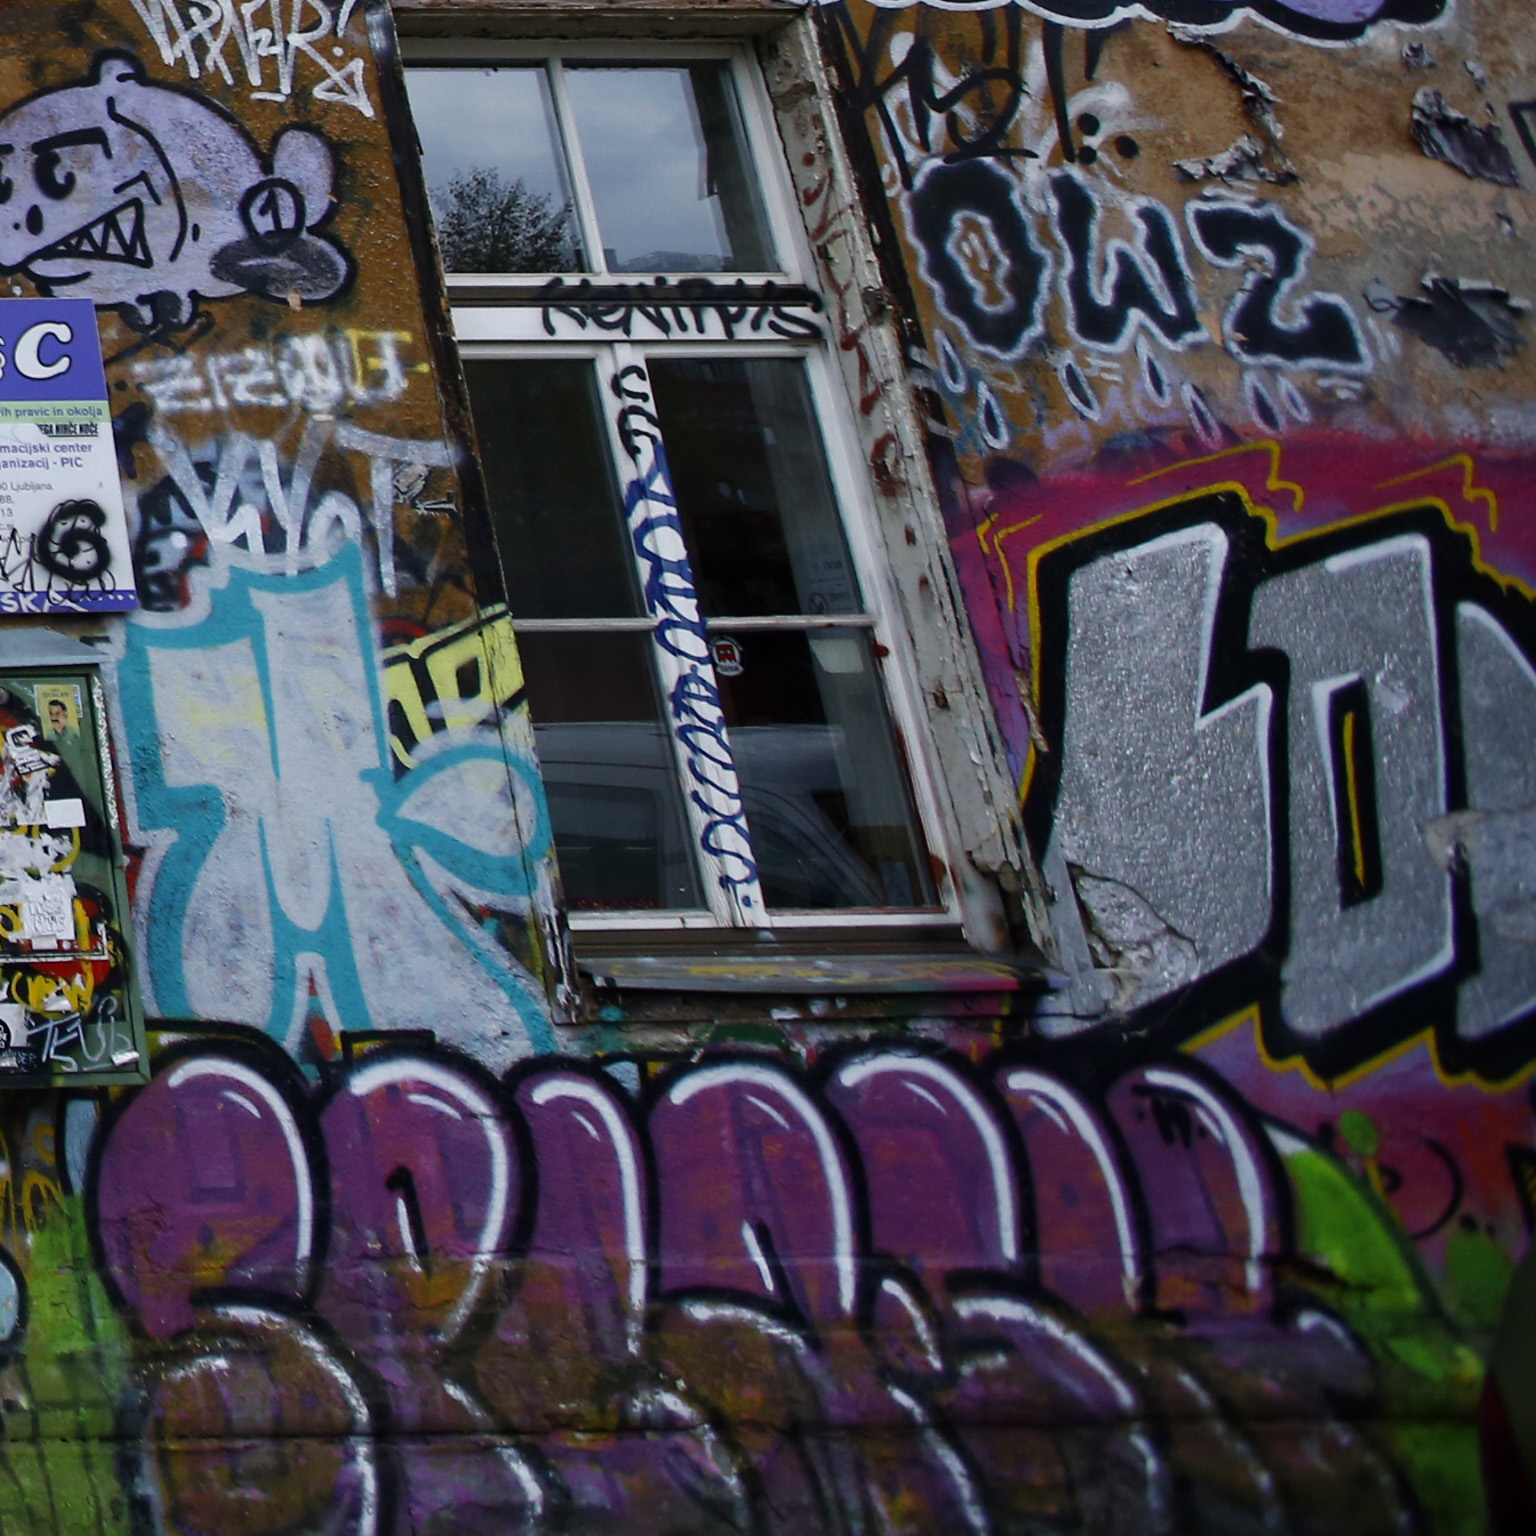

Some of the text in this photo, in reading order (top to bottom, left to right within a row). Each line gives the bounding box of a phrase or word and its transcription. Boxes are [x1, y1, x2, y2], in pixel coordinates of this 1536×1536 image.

[15, 407, 50, 420] pravic
[53, 407, 64, 417] in
[67, 406, 103, 419] okolja
[54, 444, 92, 453] center
[61, 458, 83, 468] PIC
[11, 482, 53, 493] Ljubljana
